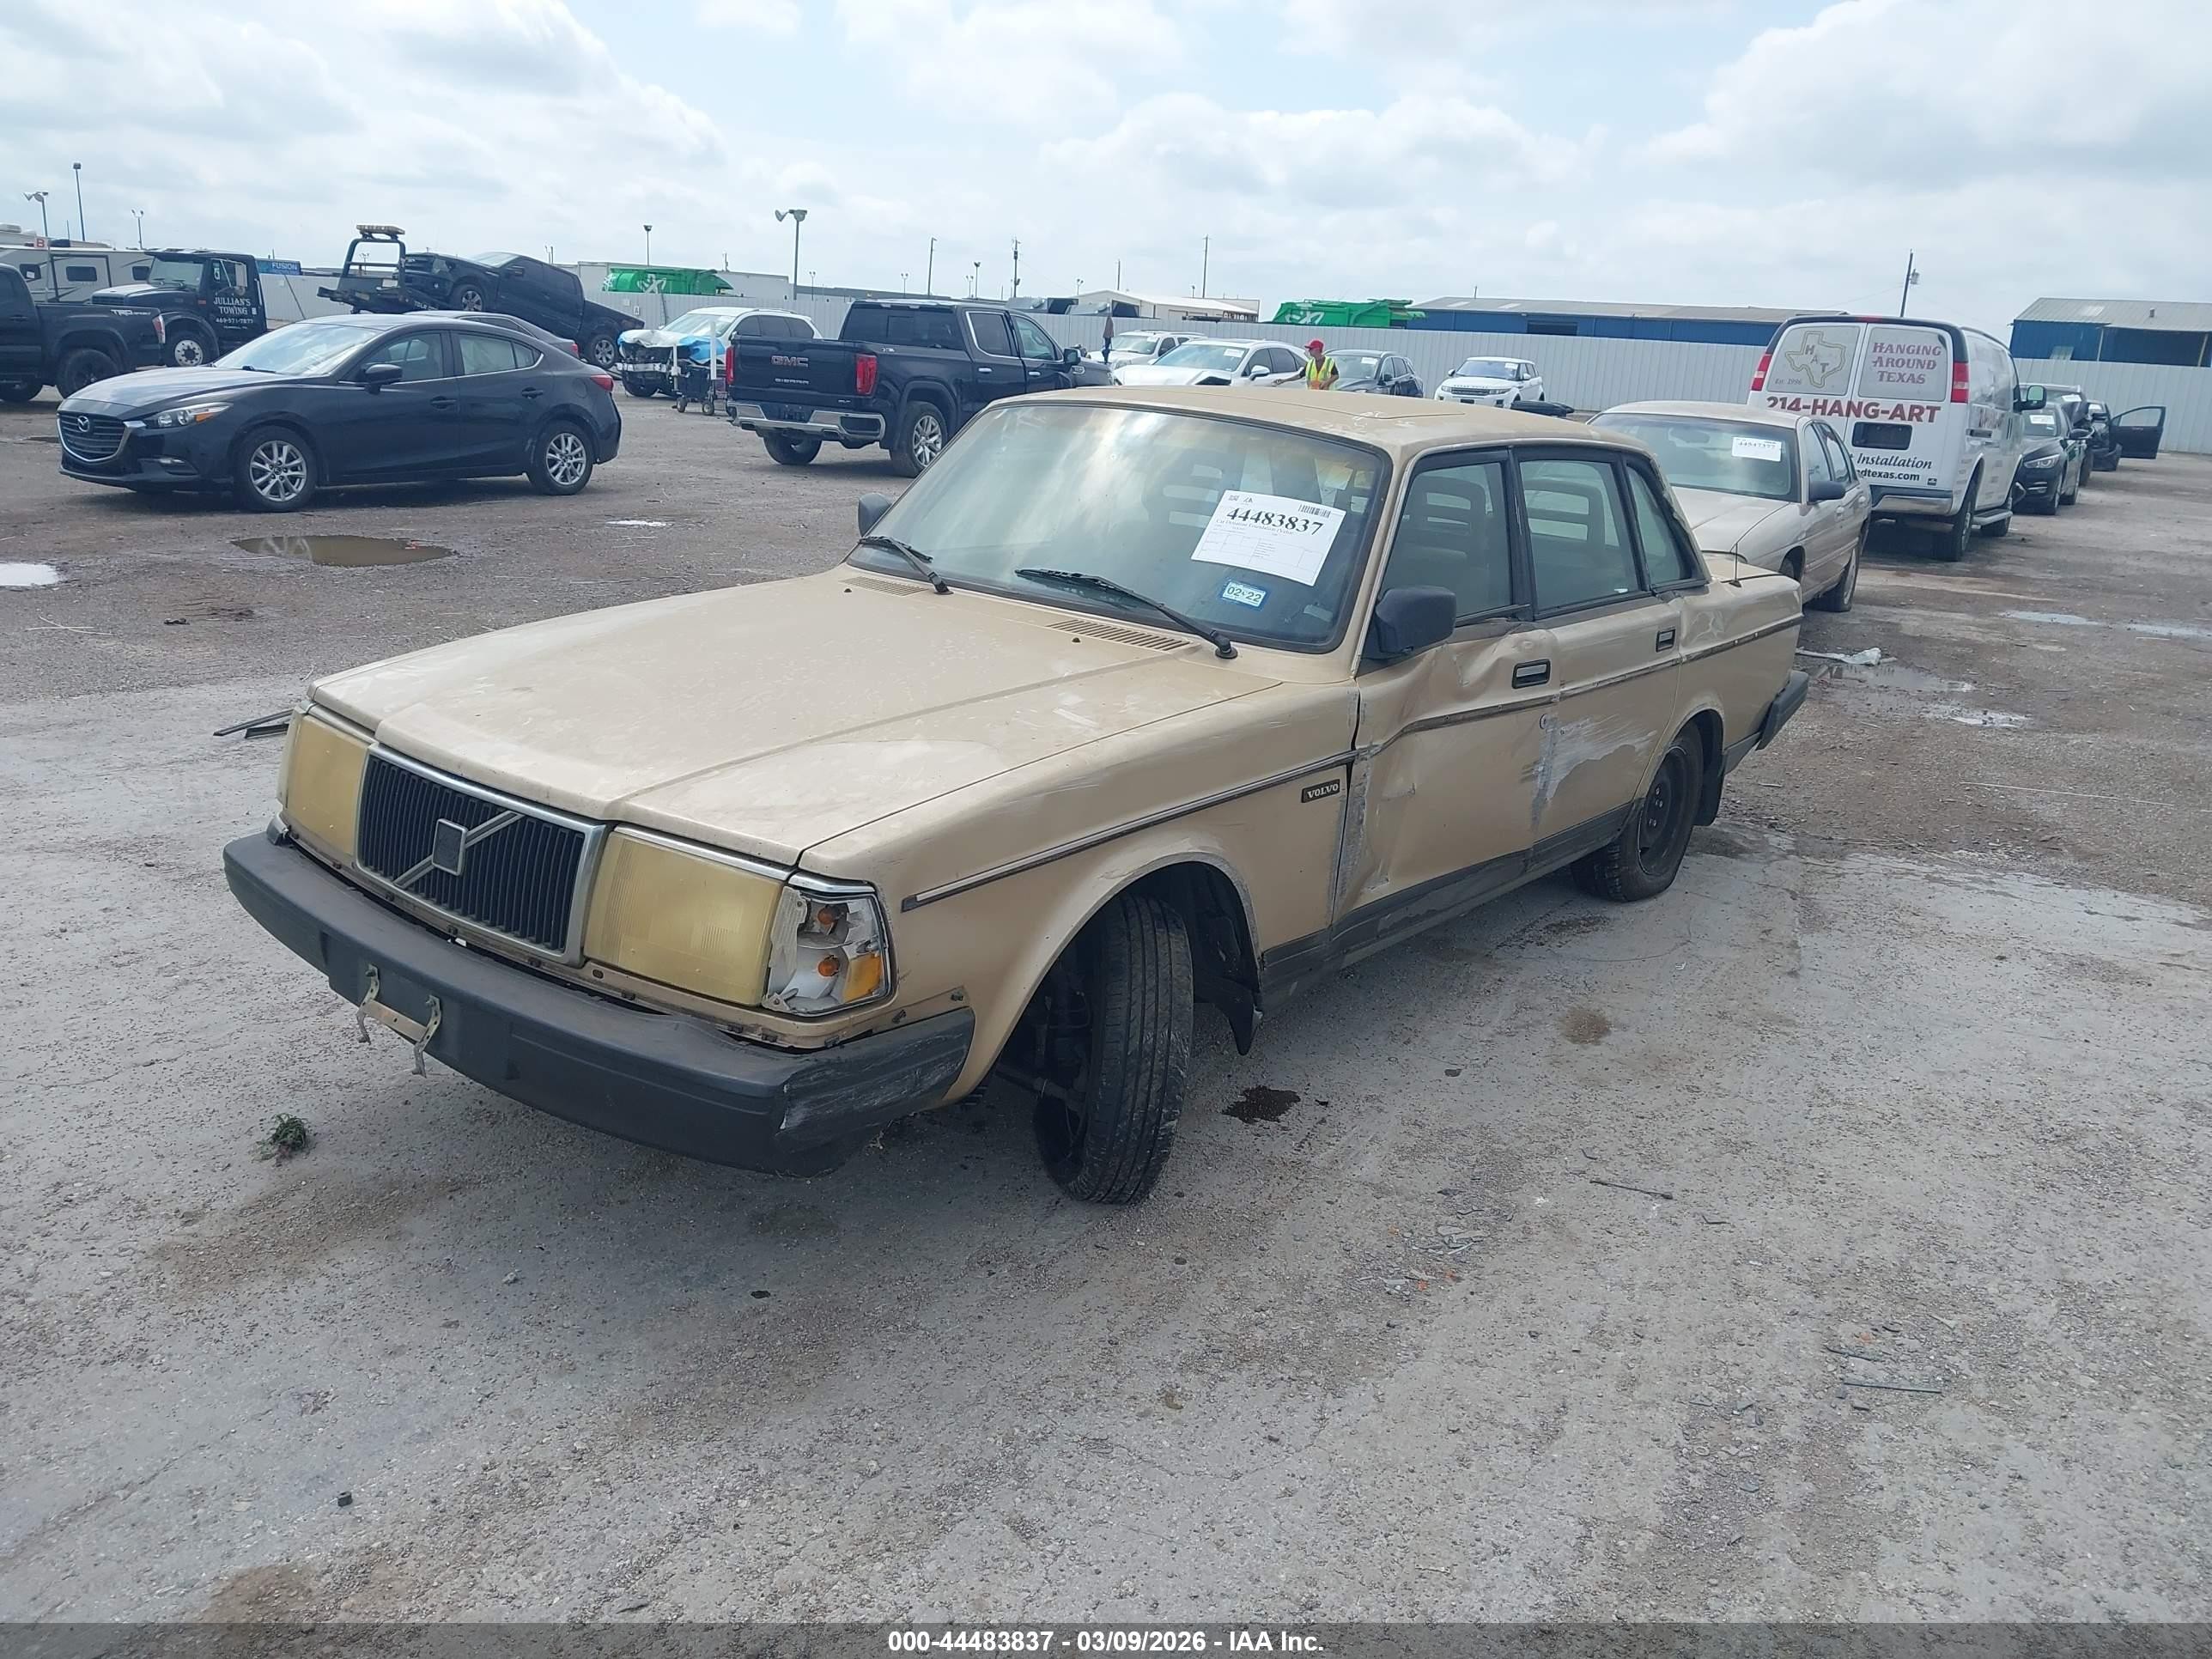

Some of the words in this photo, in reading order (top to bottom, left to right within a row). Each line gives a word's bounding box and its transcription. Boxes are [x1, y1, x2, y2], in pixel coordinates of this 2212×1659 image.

[36, 238, 45, 248] B
[271, 261, 298, 270] FUSION
[213, 296, 252, 307] JULLIAN'S
[218, 306, 248, 316] TOWING
[1872, 342, 1942, 356] HANGING
[771, 355, 809, 368] GMC
[1871, 356, 1937, 370] AROUND
[1877, 370, 1926, 385] TEXAS
[1766, 396, 1942, 422] 214-HANG-ART
[1857, 453, 1932, 470] Installation
[1225, 507, 1324, 536] 44483837
[1307, 783, 1339, 799] VOLVO
